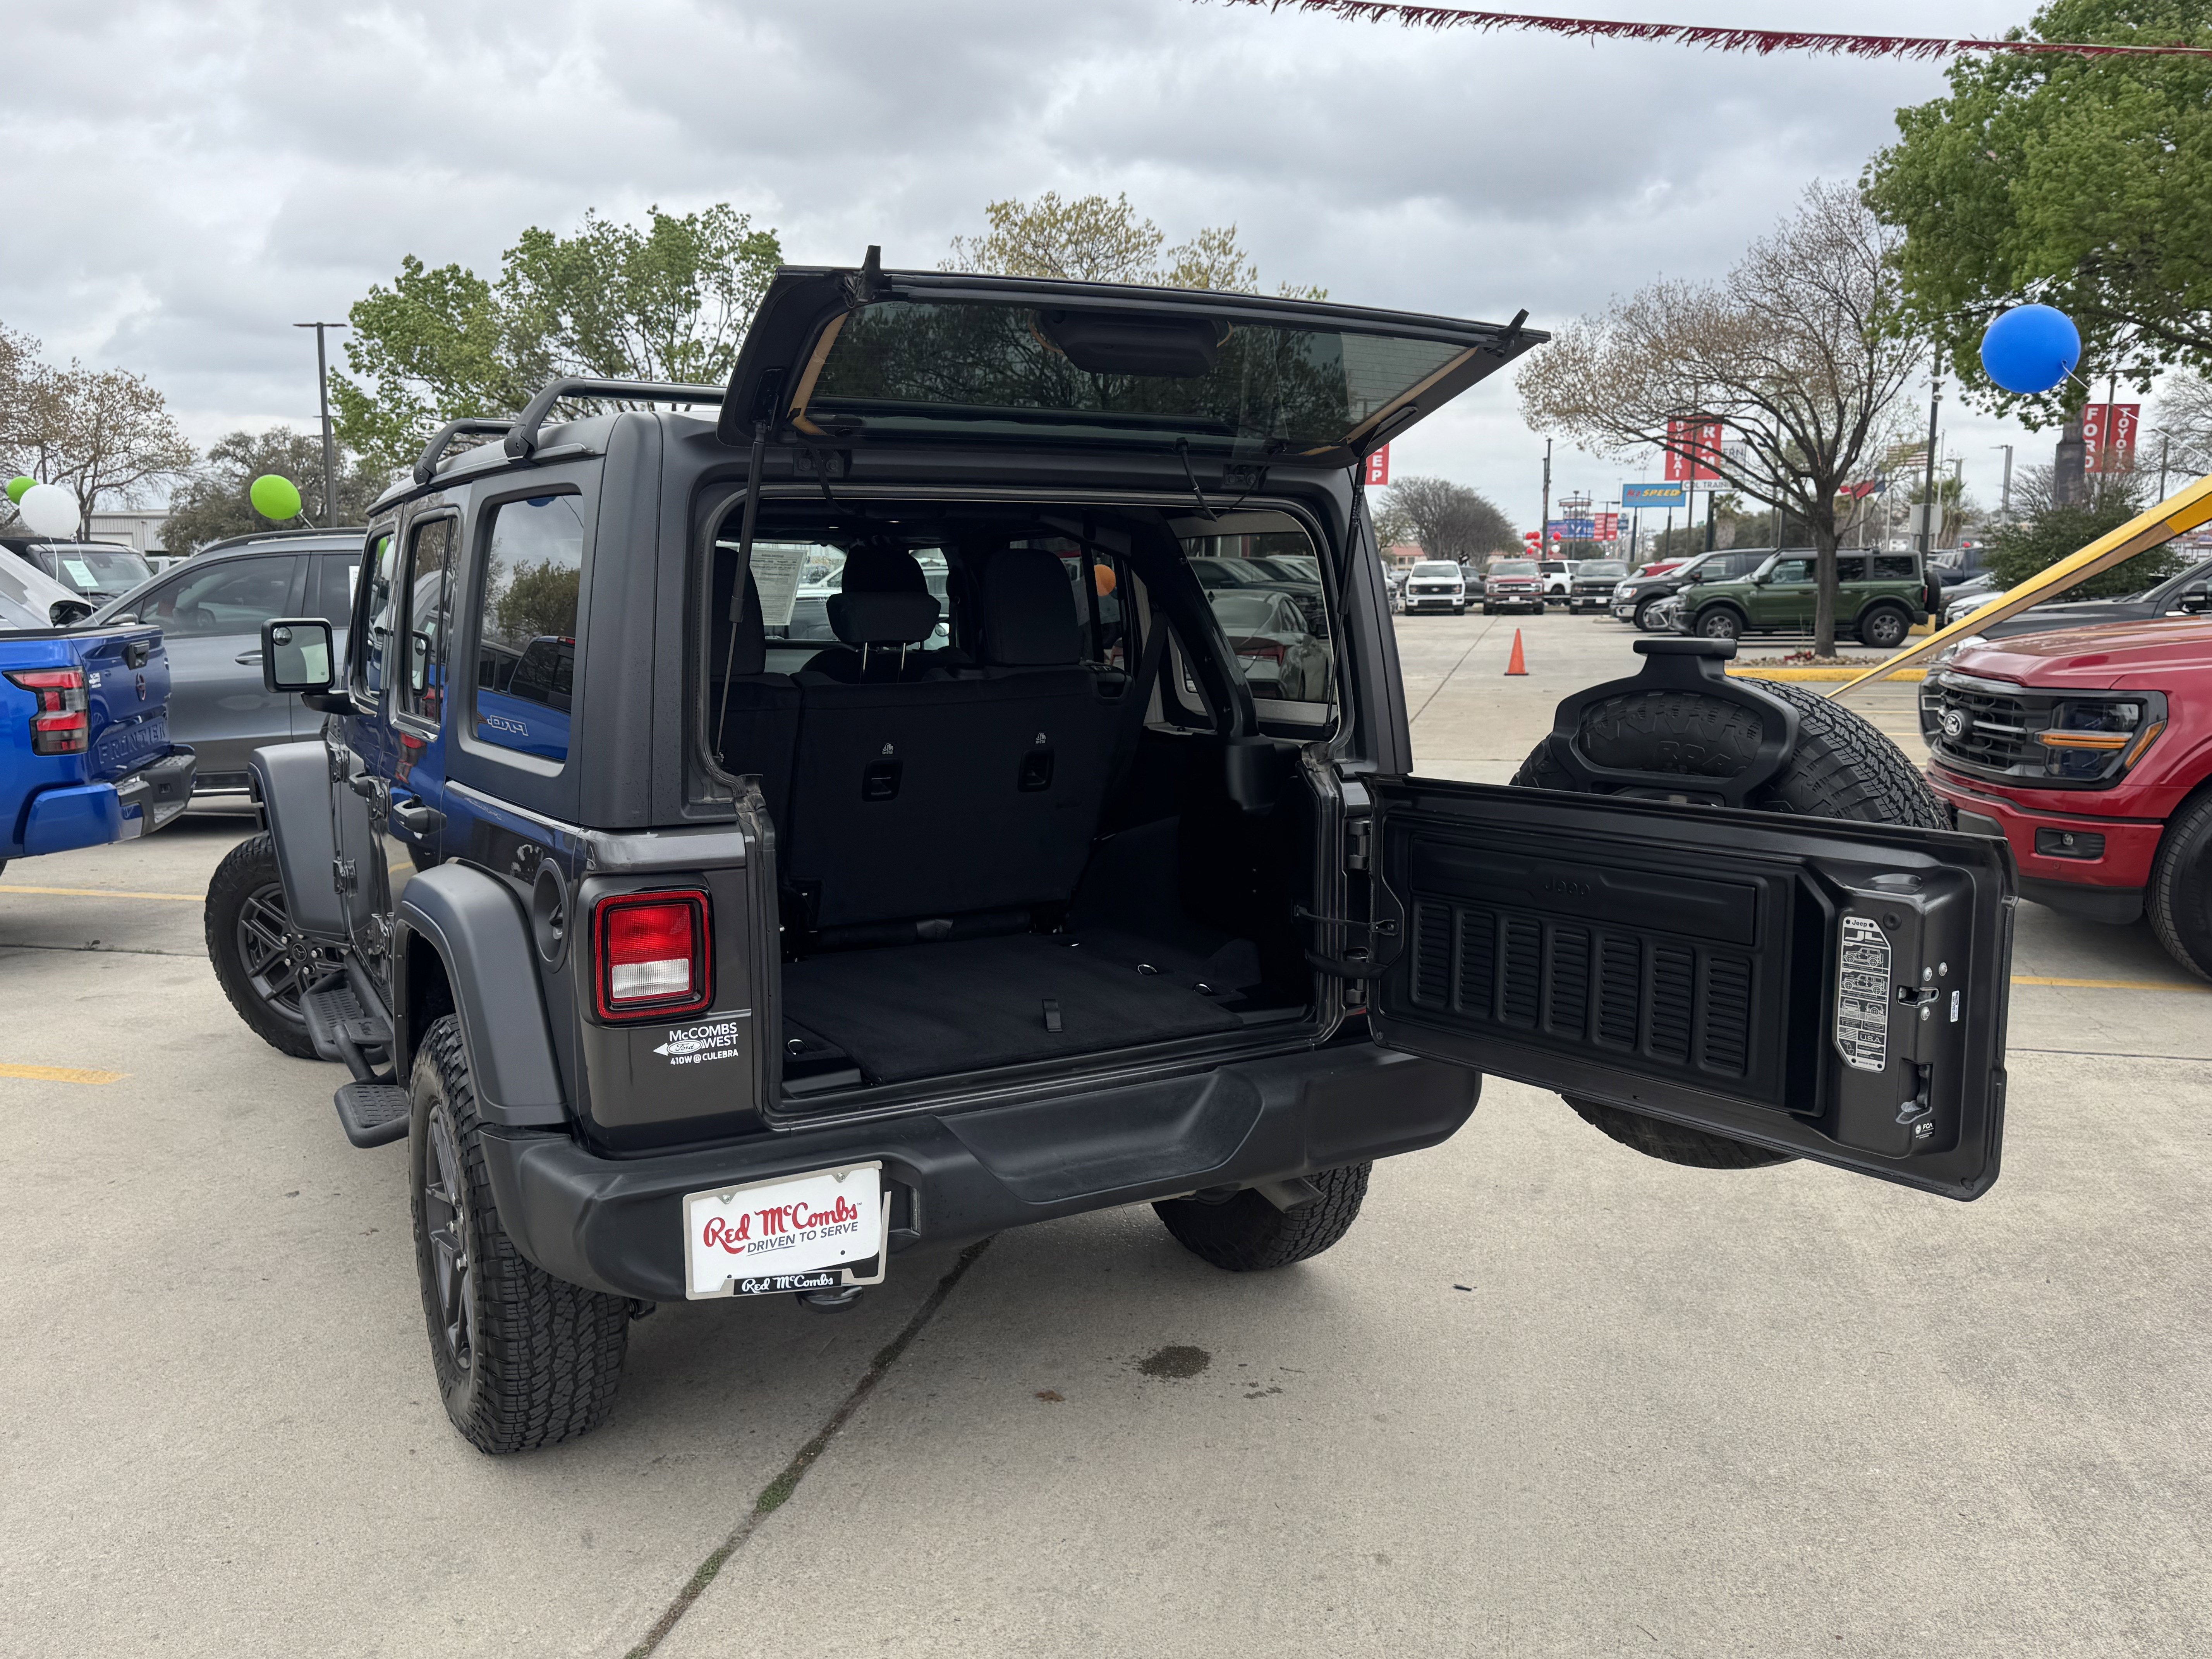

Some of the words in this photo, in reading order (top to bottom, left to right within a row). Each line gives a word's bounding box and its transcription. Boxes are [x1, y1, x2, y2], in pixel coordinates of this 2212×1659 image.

[1700, 426, 1716, 469] RAM
[2083, 407, 2099, 468] FORD
[2114, 408, 2131, 470] TOYOTA
[1372, 448, 1383, 482] EP
[1844, 930, 1884, 942] JL
[669, 1022, 737, 1042] McCOMBS
[703, 1034, 738, 1049] WEST
[670, 1055, 692, 1065] 410W
[693, 1054, 702, 1063] @
[702, 1049, 738, 1061] CULEBRA
[703, 1213, 750, 1254] Red
[754, 1196, 858, 1236] McCombs
[747, 1234, 795, 1253] DRIVEN
[799, 1230, 817, 1242] TO
[821, 1221, 859, 1238] SERVE
[741, 1278, 770, 1294] Red
[773, 1273, 834, 1289] McCombs
